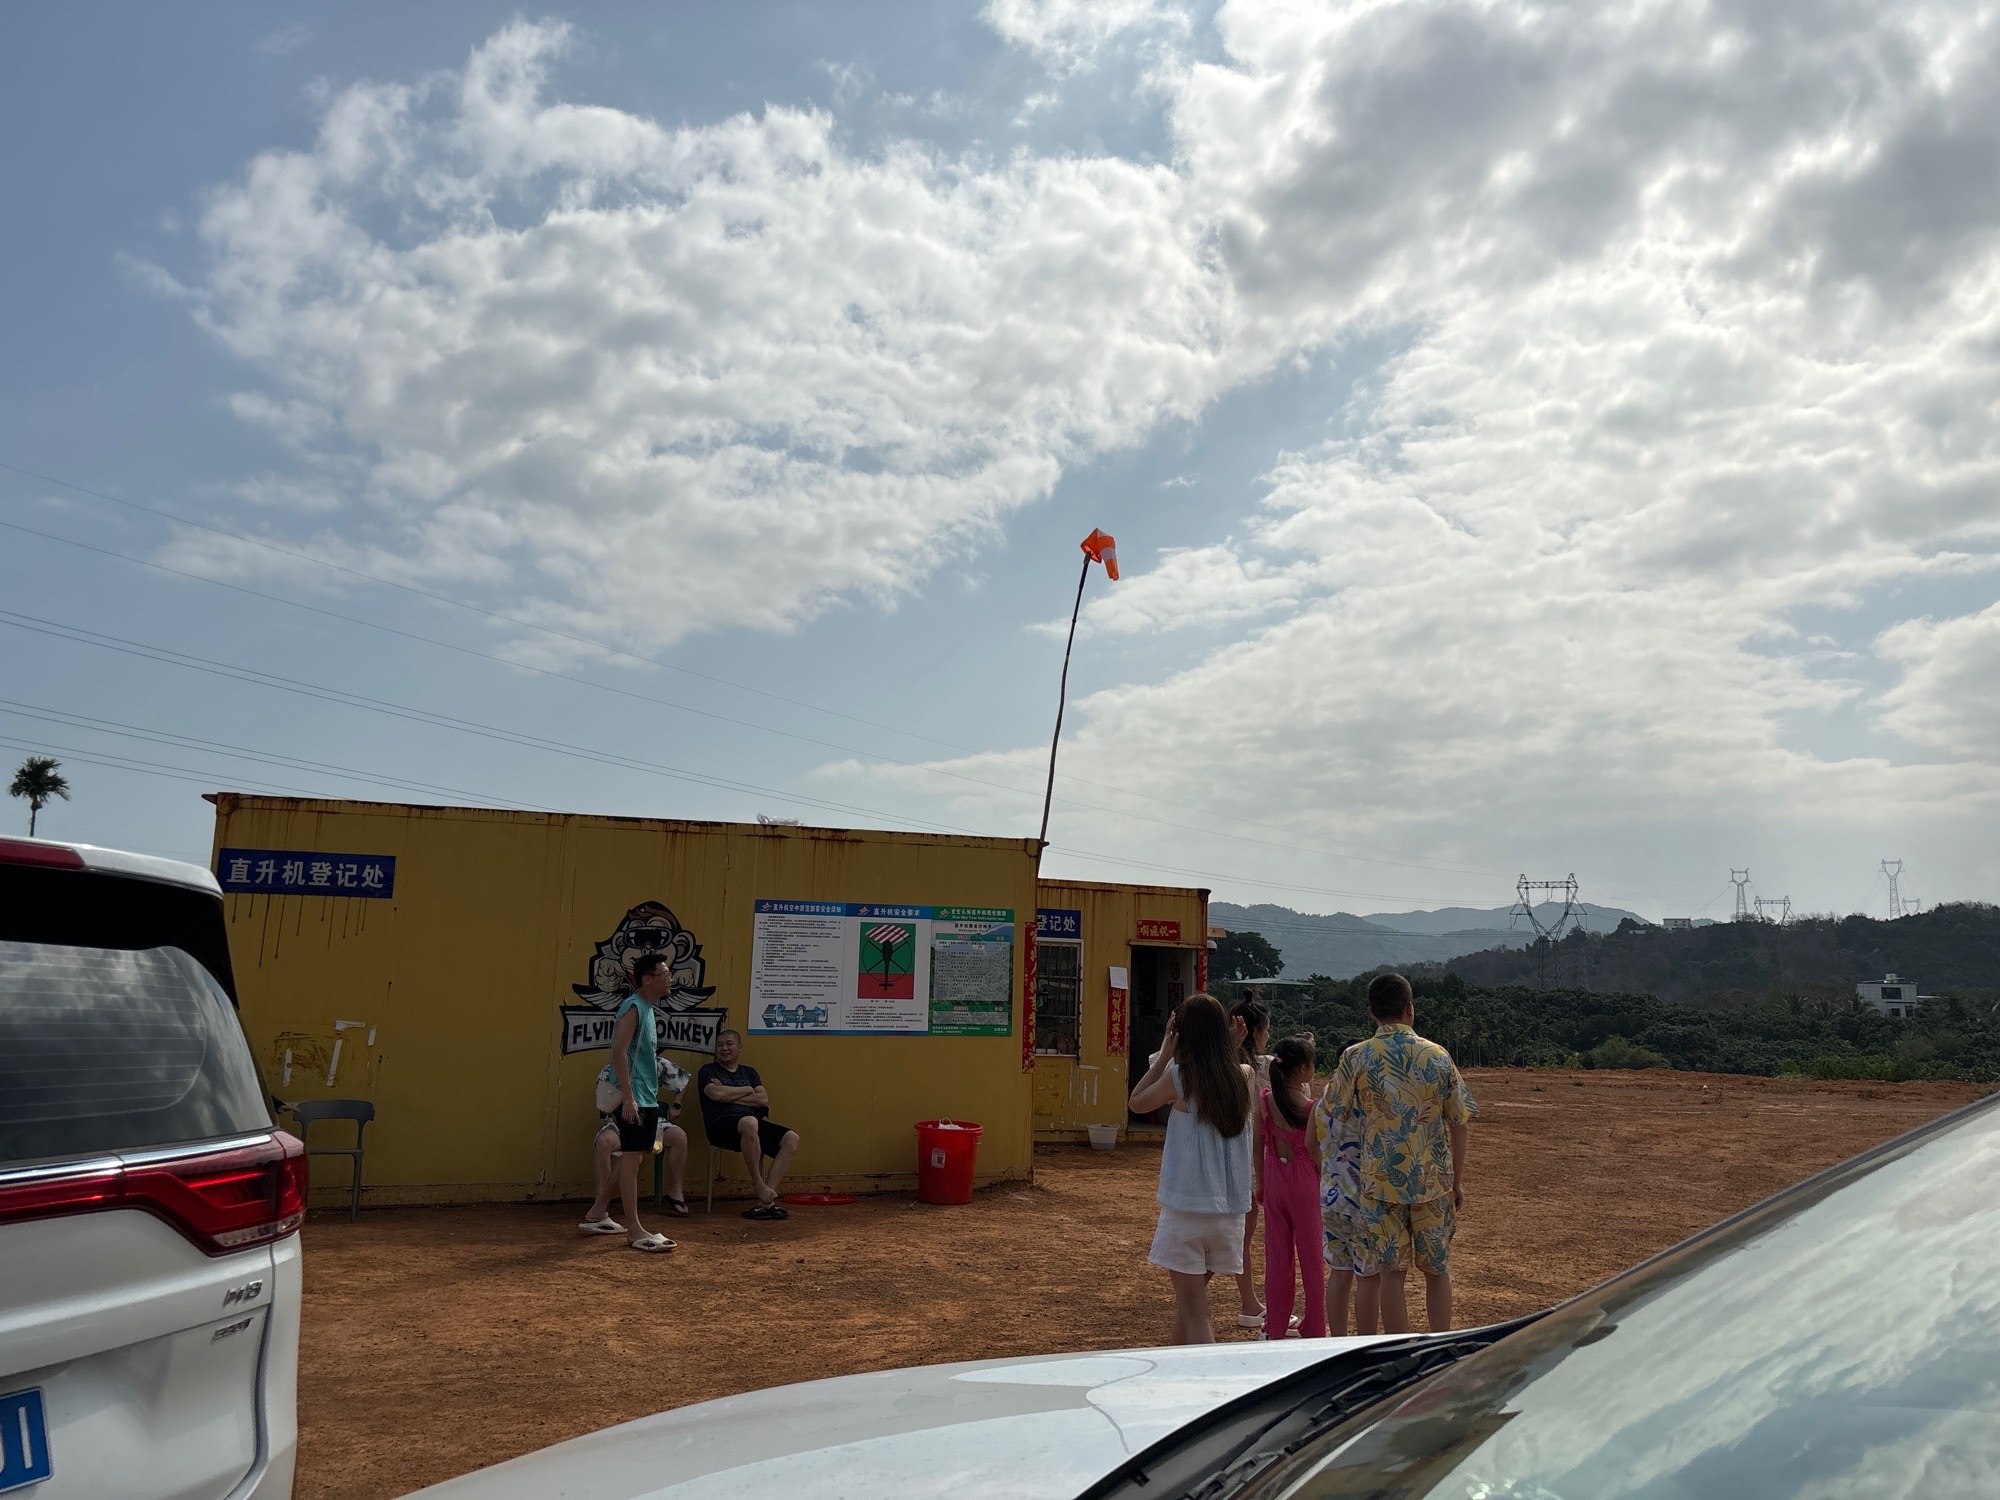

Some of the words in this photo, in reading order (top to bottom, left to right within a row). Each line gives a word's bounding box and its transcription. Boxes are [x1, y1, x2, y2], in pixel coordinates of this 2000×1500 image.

[225, 857, 385, 889] 直升机登记处
[873, 907, 921, 917] 直升机安全要求
[1036, 914, 1076, 932] 登记处
[572, 1020, 615, 1045] FLYI
[656, 1019, 714, 1045] ONKEY
